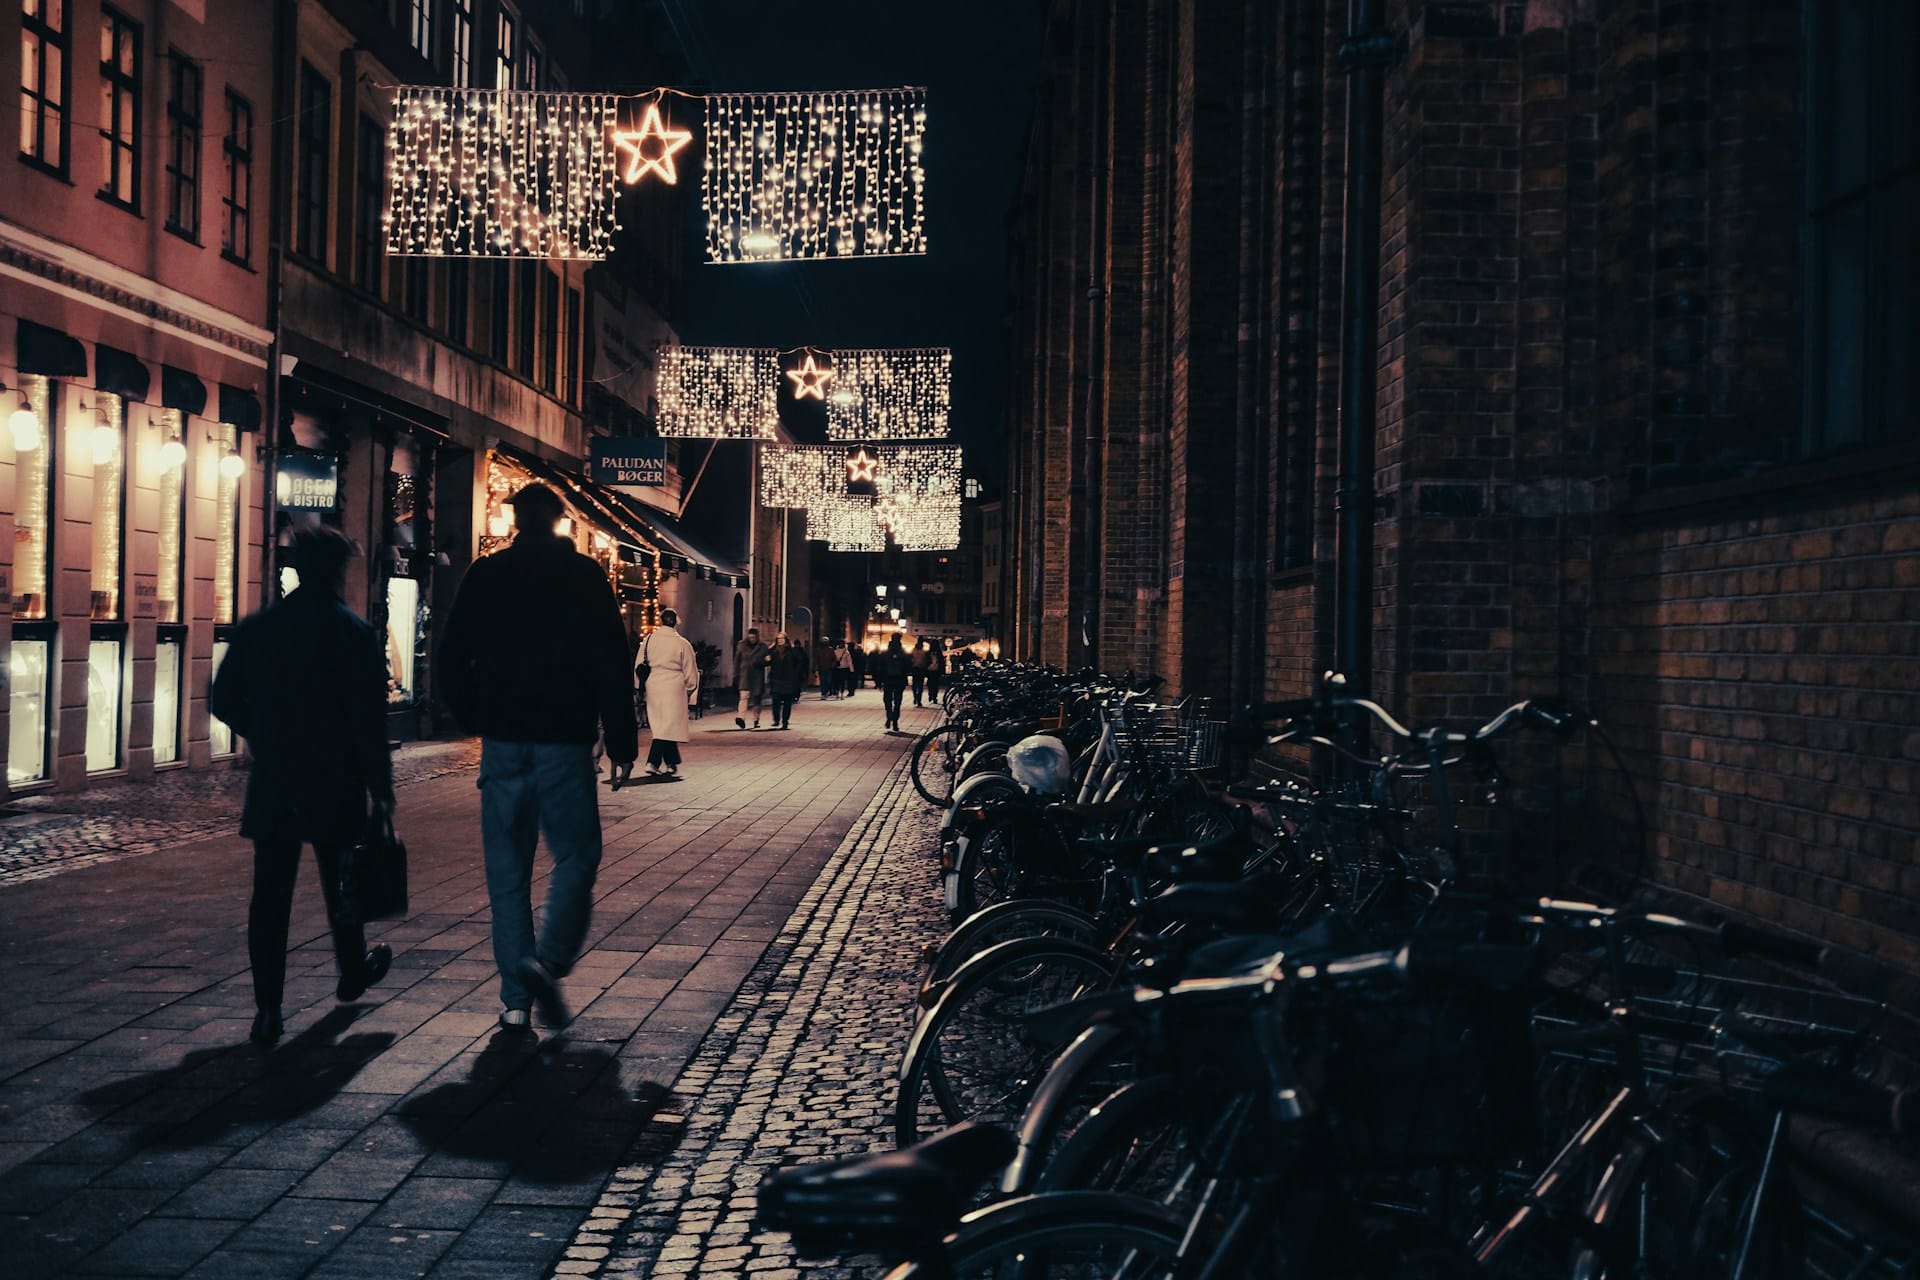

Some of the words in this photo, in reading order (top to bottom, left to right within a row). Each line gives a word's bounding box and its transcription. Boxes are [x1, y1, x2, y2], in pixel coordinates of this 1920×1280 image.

[602, 457, 663, 469] PALUDAN
[617, 470, 663, 482] BØGER
[281, 478, 334, 496] ØGER
[294, 494, 334, 508] BISTRO
